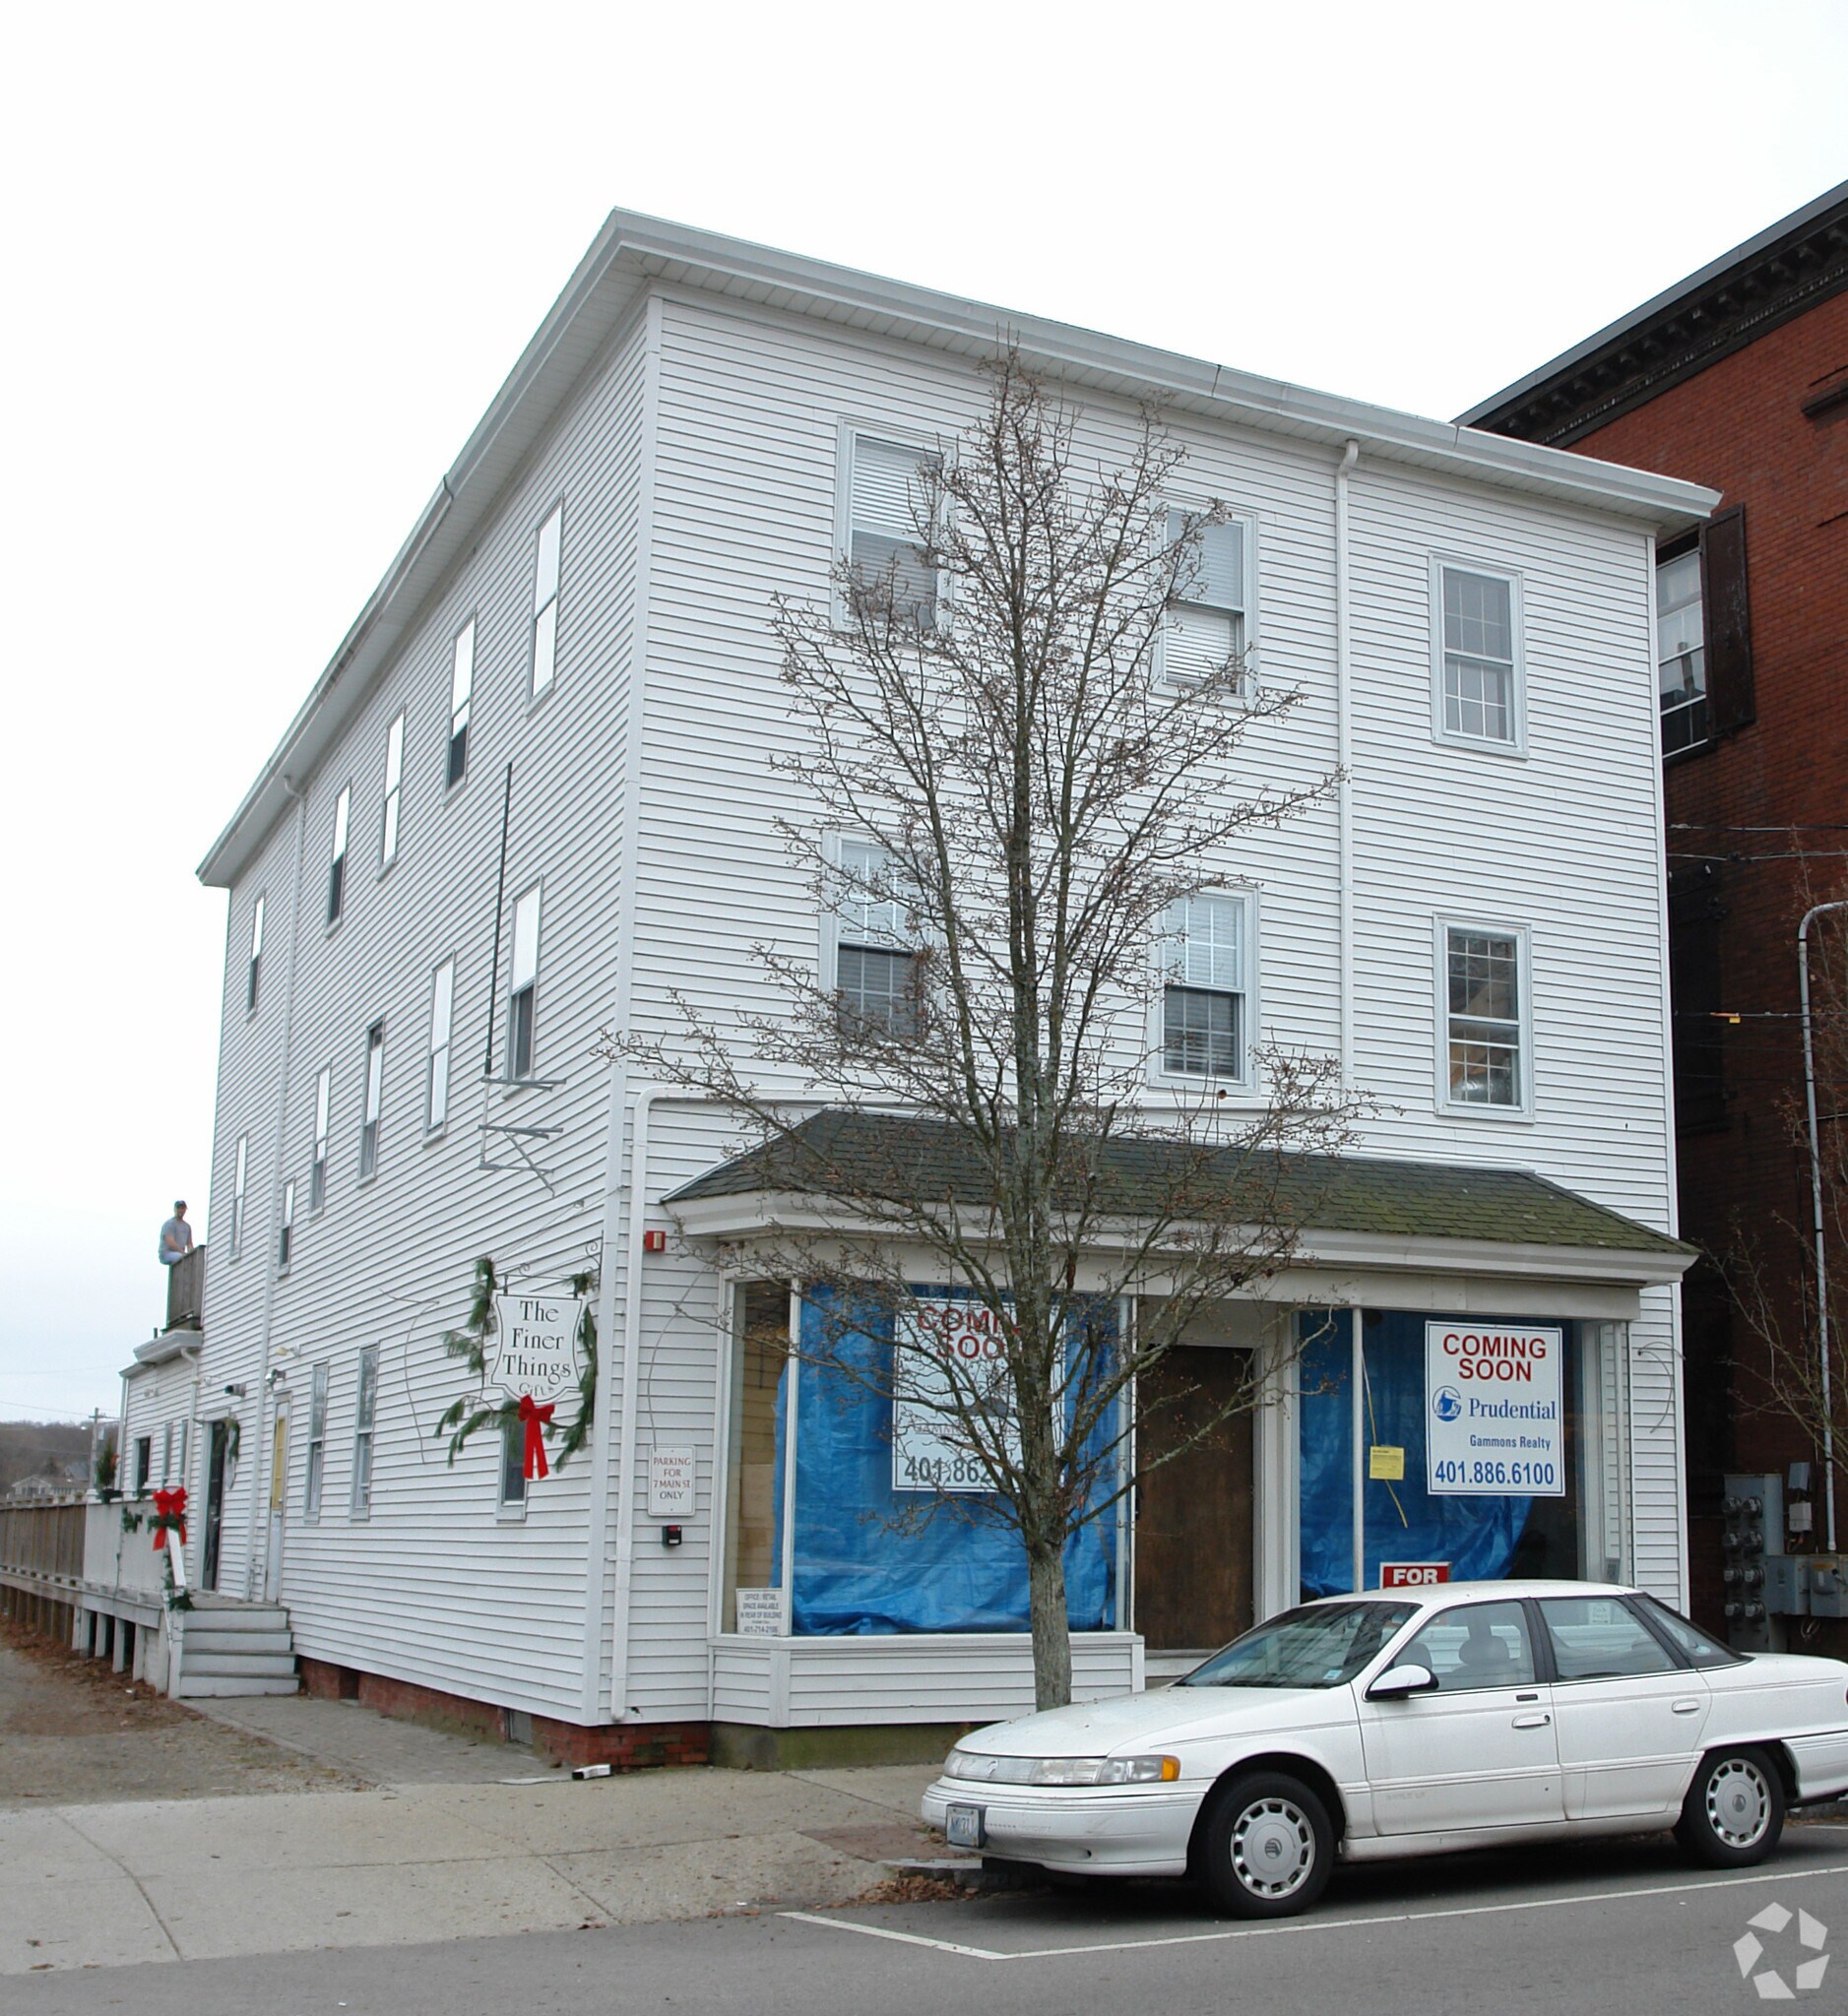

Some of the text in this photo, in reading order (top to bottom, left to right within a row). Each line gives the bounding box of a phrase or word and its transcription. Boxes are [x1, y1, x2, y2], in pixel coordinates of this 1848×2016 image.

[520, 1300, 559, 1322] The
[917, 1306, 1021, 1335] COMI
[511, 1328, 564, 1350] Finer
[936, 1334, 1006, 1359] SOO
[1442, 1333, 1547, 1359] COMING
[503, 1354, 571, 1385] Things
[1458, 1357, 1532, 1382] SOON
[1468, 1398, 1557, 1420] Prudential
[1470, 1434, 1551, 1451] Gammons Realty
[654, 1457, 691, 1466] PARKING
[1434, 1460, 1555, 1485] 401.886.6100
[654, 1480, 659, 1488] 7
[660, 1480, 681, 1488] MAIN
[1393, 1568, 1438, 1585] FOR
